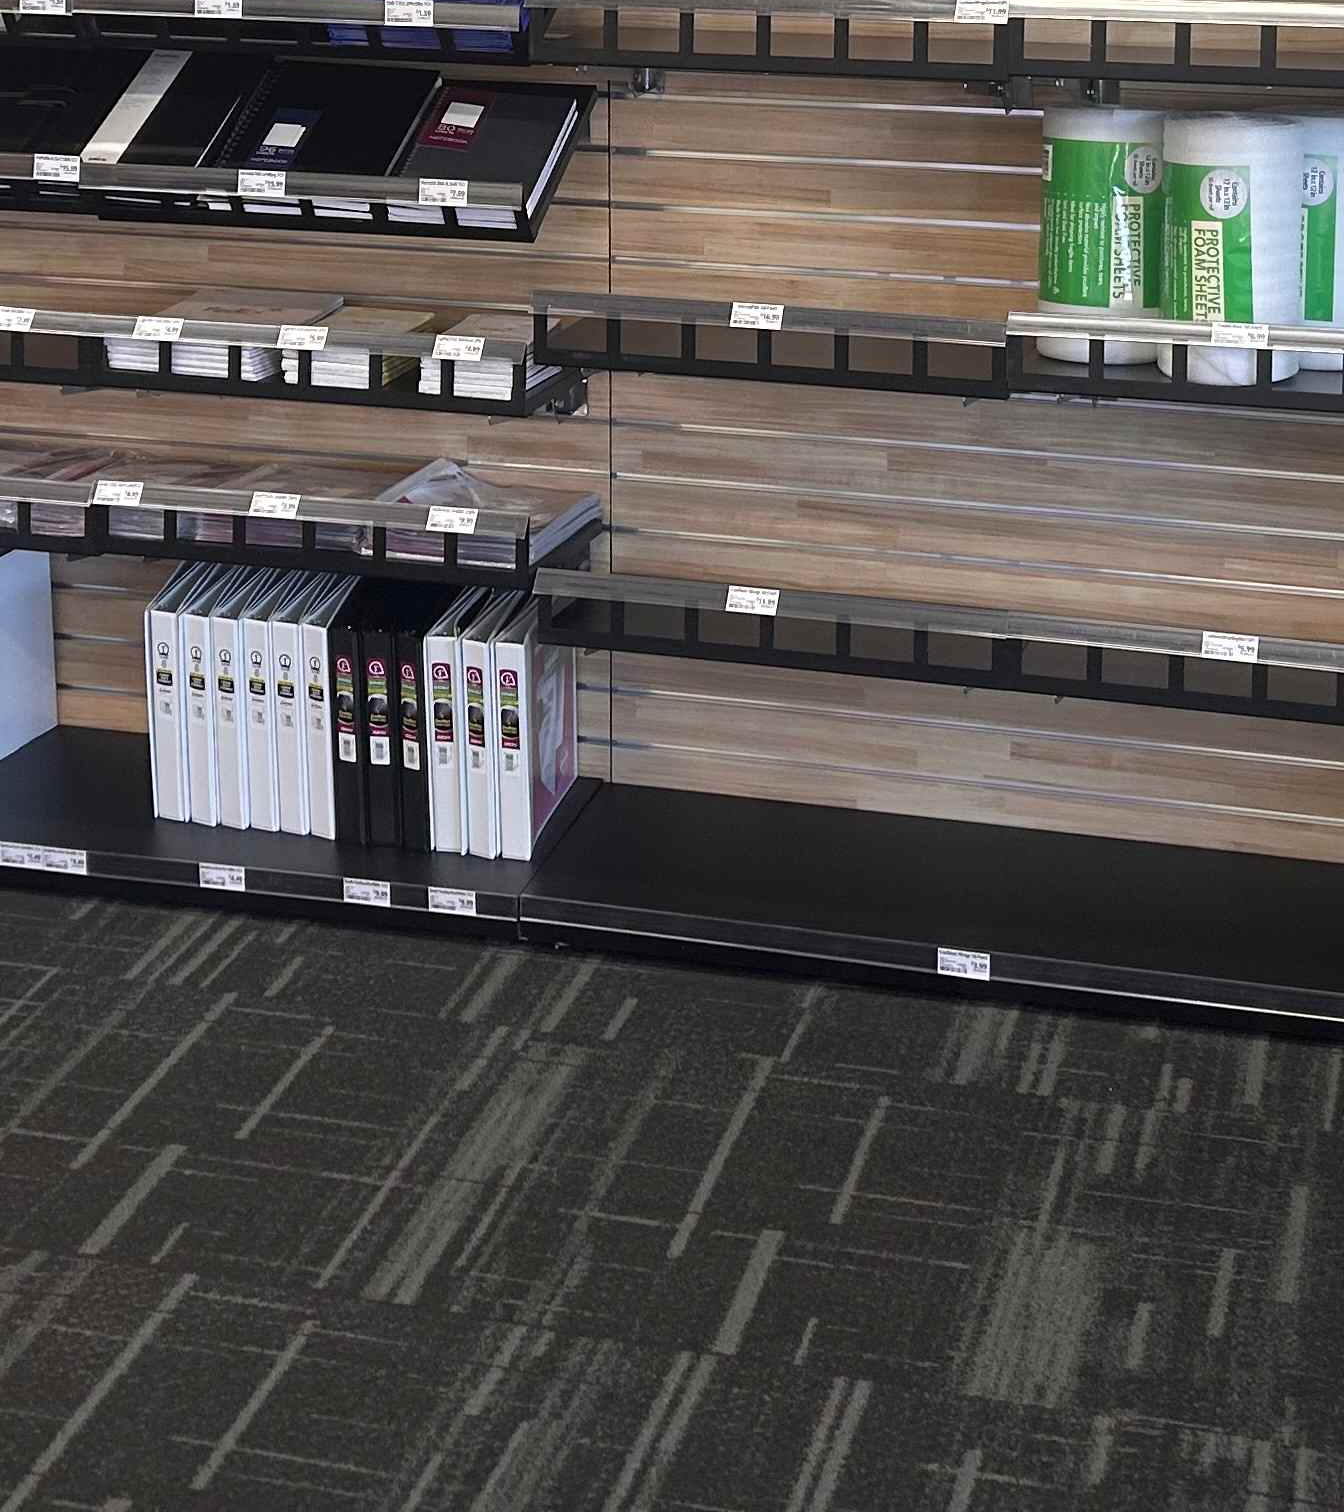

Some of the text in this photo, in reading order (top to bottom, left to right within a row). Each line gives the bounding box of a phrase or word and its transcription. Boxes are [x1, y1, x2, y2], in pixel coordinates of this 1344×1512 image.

[1129, 203, 1141, 287] PROTECTIVE
[1193, 228, 1206, 271] FOAM
[1206, 229, 1221, 314] PROTECTIVE
